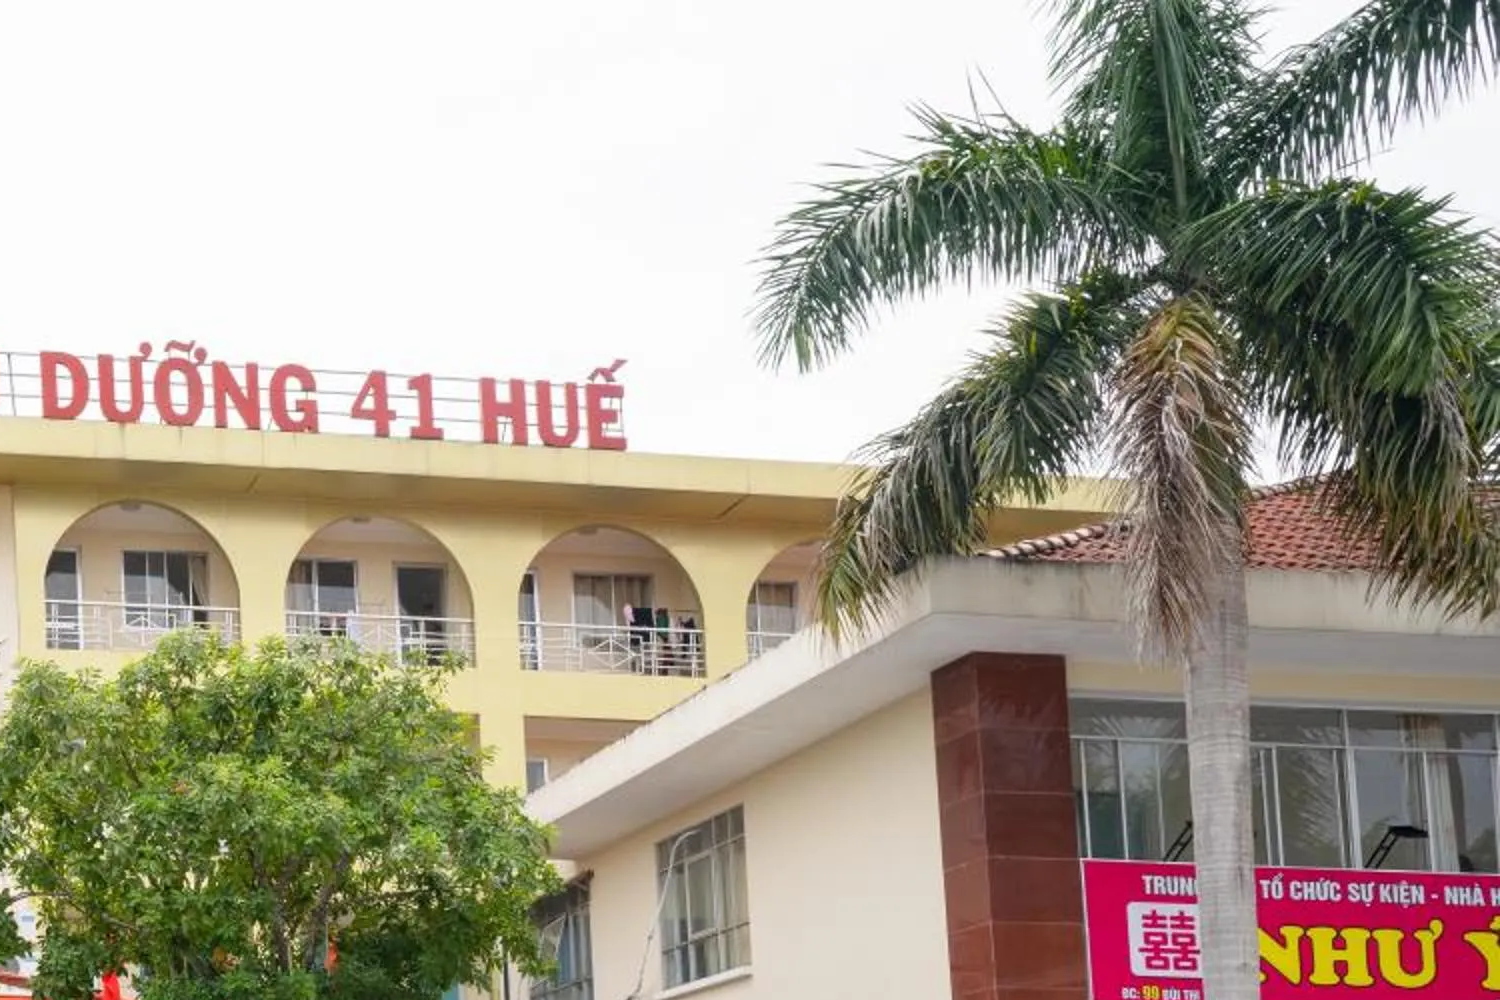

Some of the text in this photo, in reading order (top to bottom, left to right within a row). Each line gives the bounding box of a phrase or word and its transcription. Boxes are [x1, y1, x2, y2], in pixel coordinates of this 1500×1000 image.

[40, 340, 319, 434] DƯỠNG
[351, 370, 443, 440] 41
[480, 359, 628, 450] HUẾ
[1260, 872, 1284, 900] TỔ
[1289, 878, 1342, 903] CHỨC
[1347, 880, 1376, 909] SỰ
[1380, 879, 1425, 909] KIỆN
[1444, 882, 1486, 907] NHÀ
[1258, 916, 1443, 990] NHƯ
[1141, 984, 1160, 1000] 99
